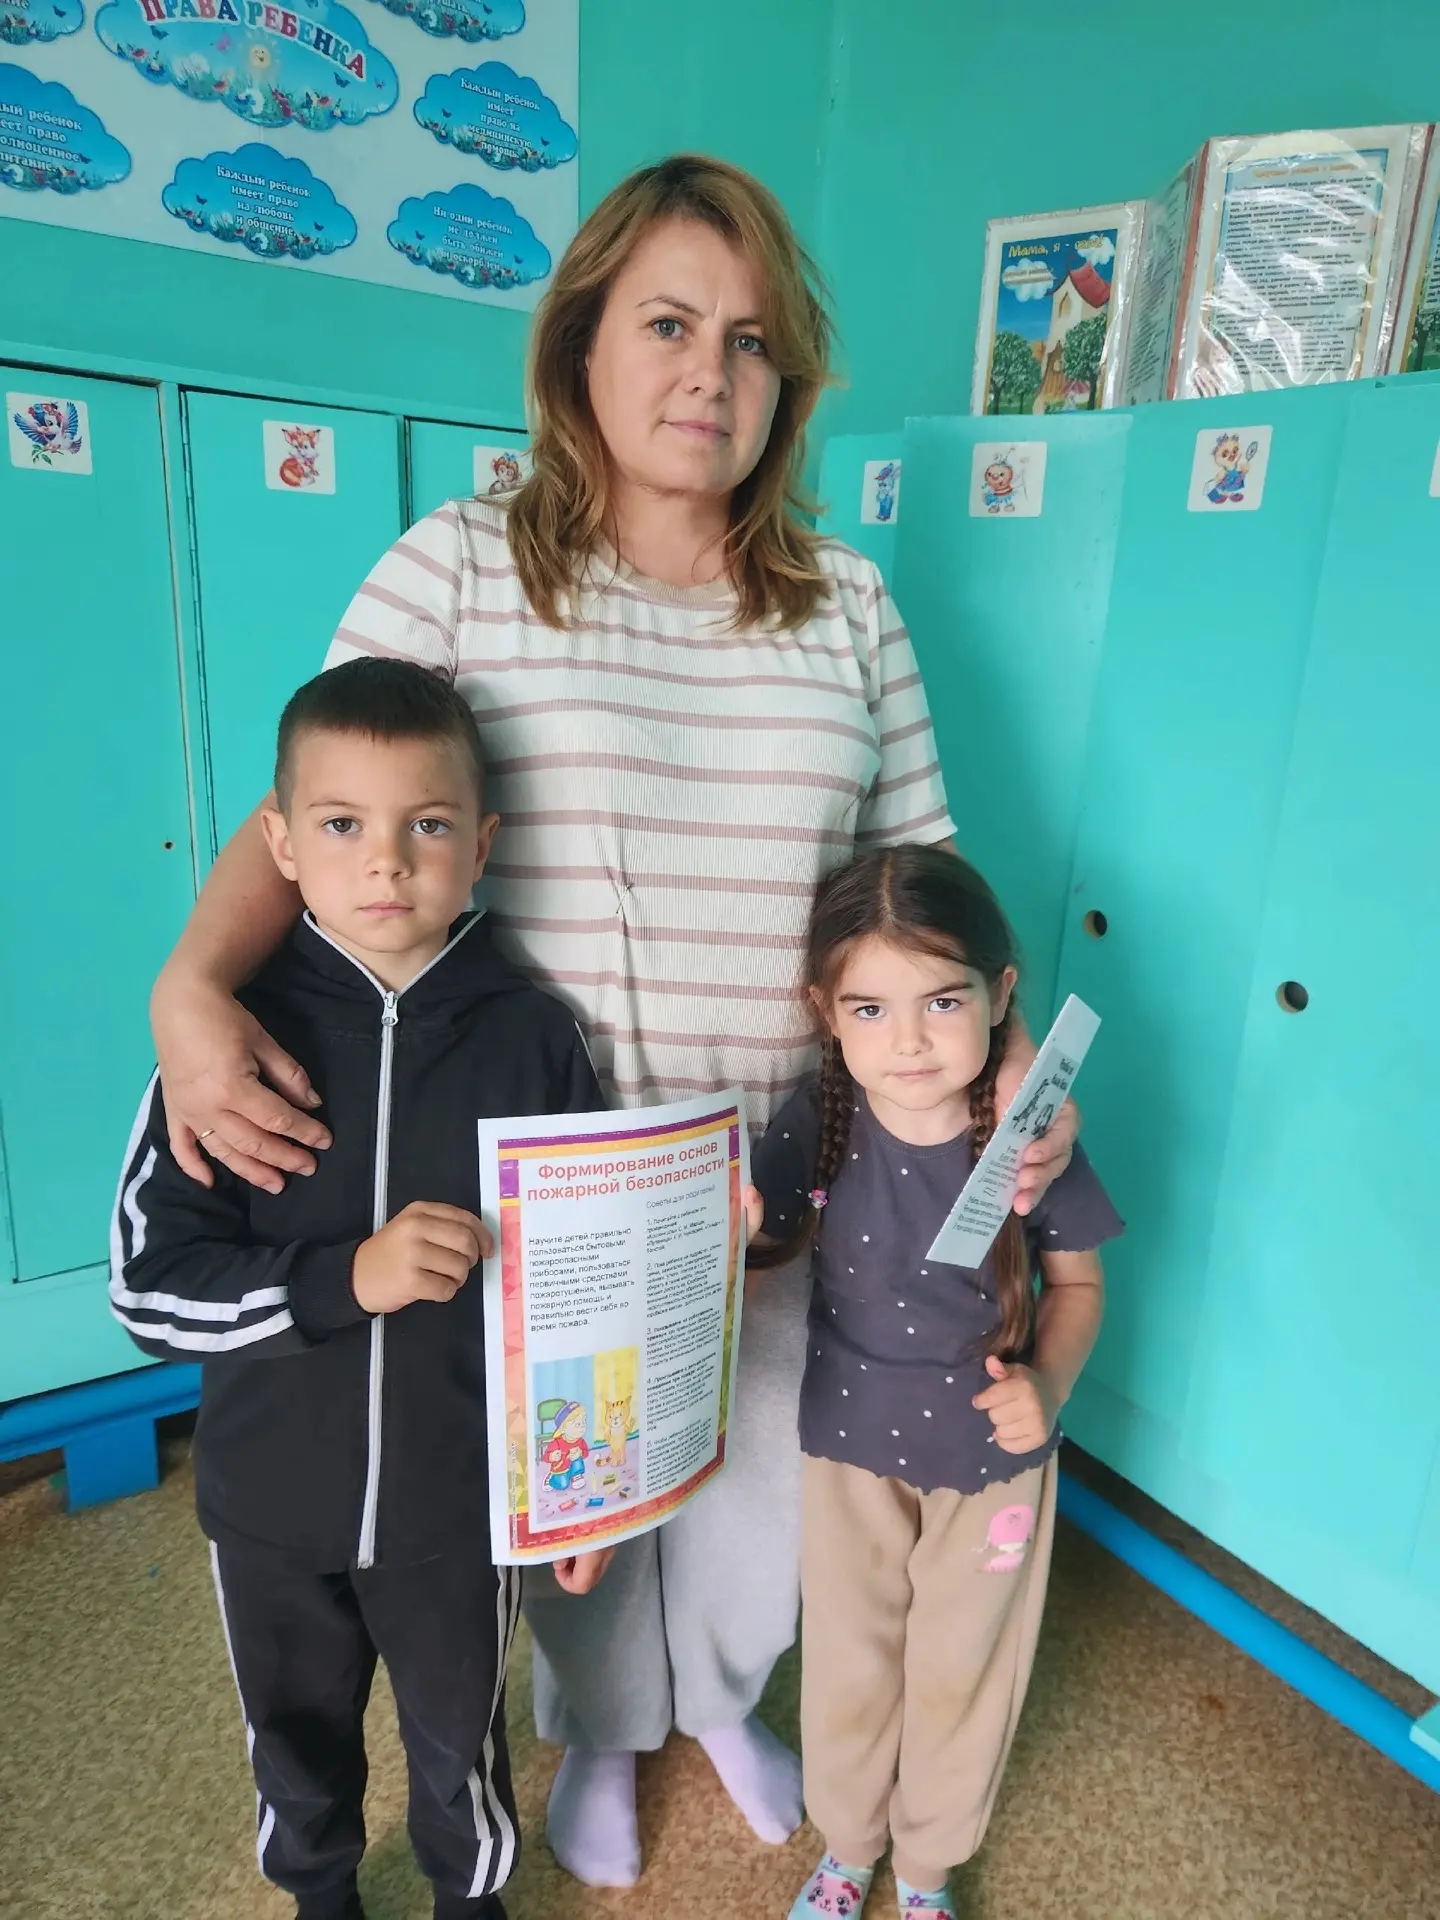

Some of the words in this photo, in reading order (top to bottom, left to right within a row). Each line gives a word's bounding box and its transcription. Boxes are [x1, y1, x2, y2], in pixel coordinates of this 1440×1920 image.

[140, 0, 238, 21] ПРАВА
[247, 3, 364, 79] РЕБЕНКА
[461, 77, 501, 98] Каждый
[504, 93, 540, 110] ребенок
[487, 101, 515, 116] имеет
[28, 109, 82, 131] ребенок
[480, 114, 507, 127] право
[509, 122, 521, 131] на
[0, 118, 22, 132] еет
[27, 124, 67, 143] право
[468, 124, 532, 147] медицинскую
[0, 135, 80, 162] олноценное
[217, 165, 265, 186] Каждый
[269, 180, 311, 198] ребенок
[231, 185, 265, 200] имеет
[268, 194, 299, 208] право
[236, 216, 243, 225] и
[237, 201, 250, 211] на
[255, 205, 295, 221] любовь
[433, 205, 447, 218] Ни
[449, 213, 473, 225] один
[476, 219, 513, 234] ребенок
[448, 225, 460, 235] не
[463, 229, 498, 244] должен
[442, 235, 466, 249] быть
[469, 242, 504, 257] обижен
[1008, 245, 1048, 258] Мама,
[538, 1153, 674, 1181] Формирование
[678, 1141, 718, 1161] основ
[527, 1178, 620, 1201] пожарной
[626, 1157, 725, 1192] безопасности
[646, 1197, 672, 1209] Советы
[528, 1236, 562, 1247] Научите
[564, 1232, 588, 1244] детей
[590, 1228, 632, 1240] правильно
[529, 1244, 584, 1257] пользоваться
[586, 1240, 626, 1251] бытовыми
[529, 1254, 600, 1267] пожароопасными
[529, 1267, 577, 1279] приборами,
[578, 1259, 631, 1273] пользоваться
[529, 1278, 580, 1290] первичными
[582, 1270, 628, 1284] средствами
[530, 1286, 596, 1299] пожаротушения,
[598, 1280, 634, 1291] вызывать
[530, 1299, 572, 1310] пожарную
[573, 1296, 604, 1306] помощь
[530, 1310, 574, 1322] правильно
[576, 1306, 598, 1316] вести
[600, 1302, 618, 1312] себя
[619, 1301, 629, 1309] во
[531, 1322, 557, 1333] время
[558, 1318, 590, 1329] пожара.
